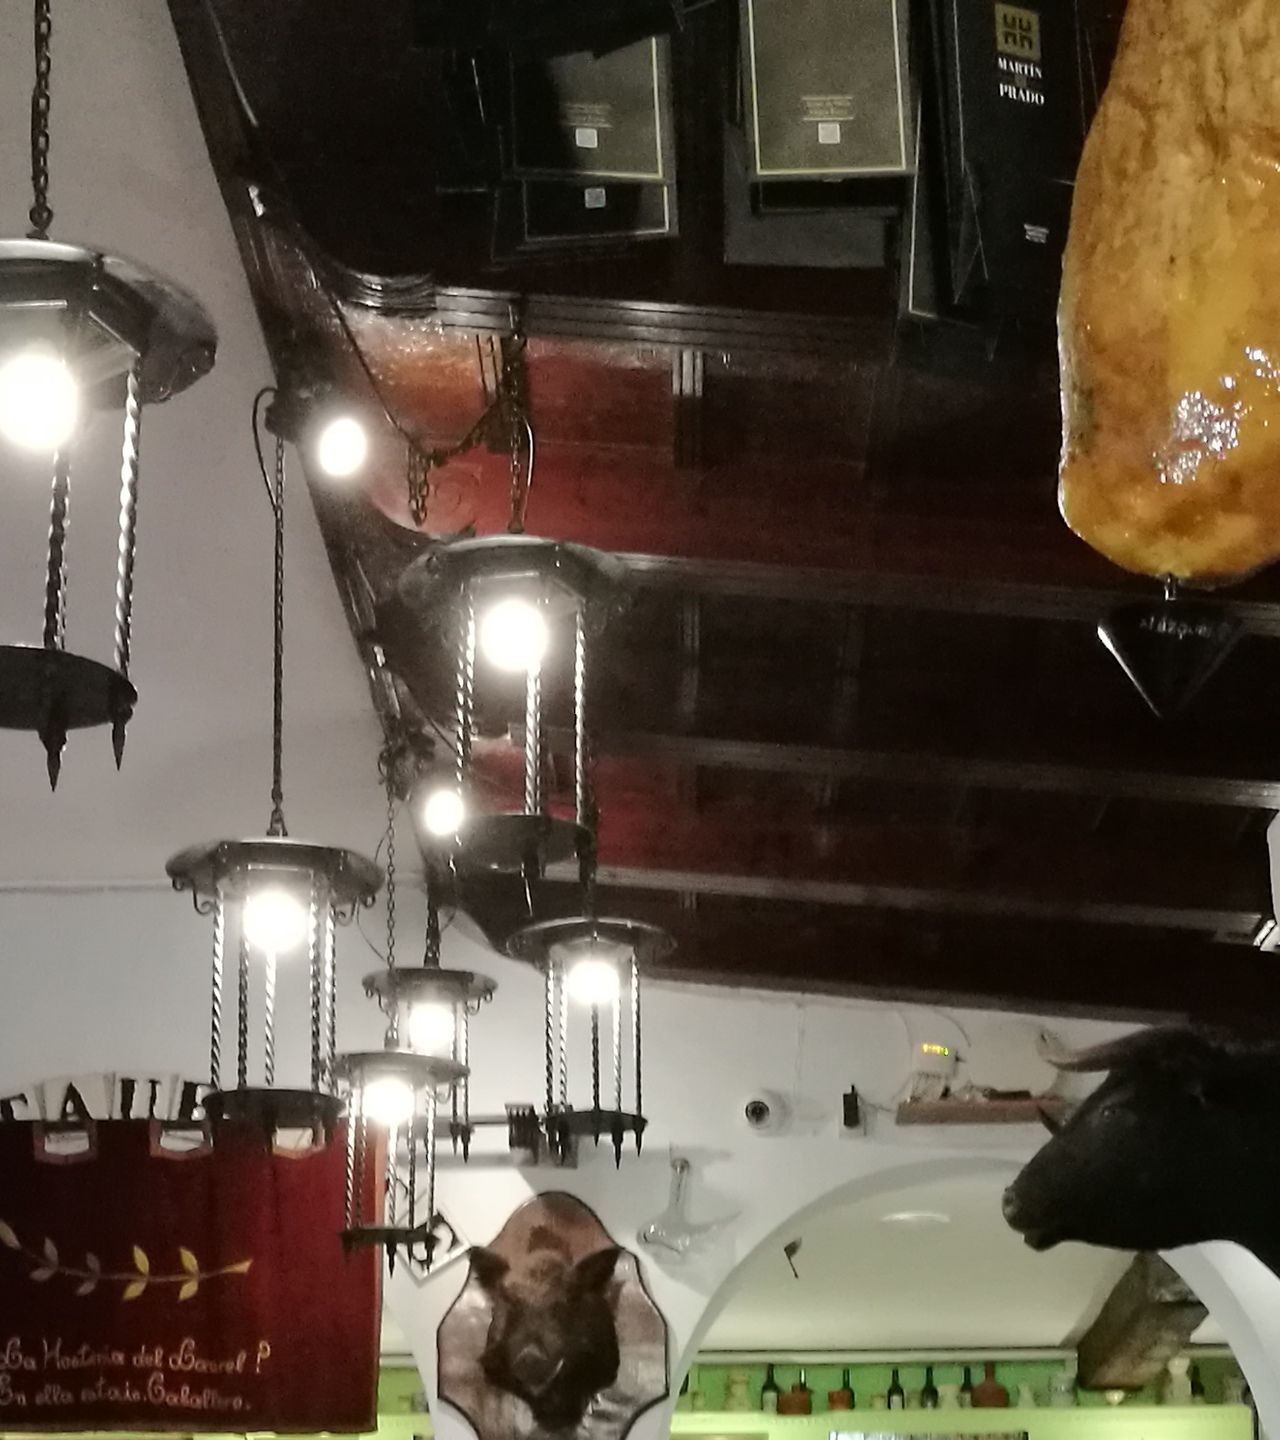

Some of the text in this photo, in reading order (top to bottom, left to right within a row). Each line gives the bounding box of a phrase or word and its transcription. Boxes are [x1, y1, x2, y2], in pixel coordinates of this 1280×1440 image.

[999, 83, 1045, 105] PRADO
[132, 1344, 164, 1368] del
[168, 1337, 247, 1374] Laurel
[34, 1383, 75, 1406] ella
